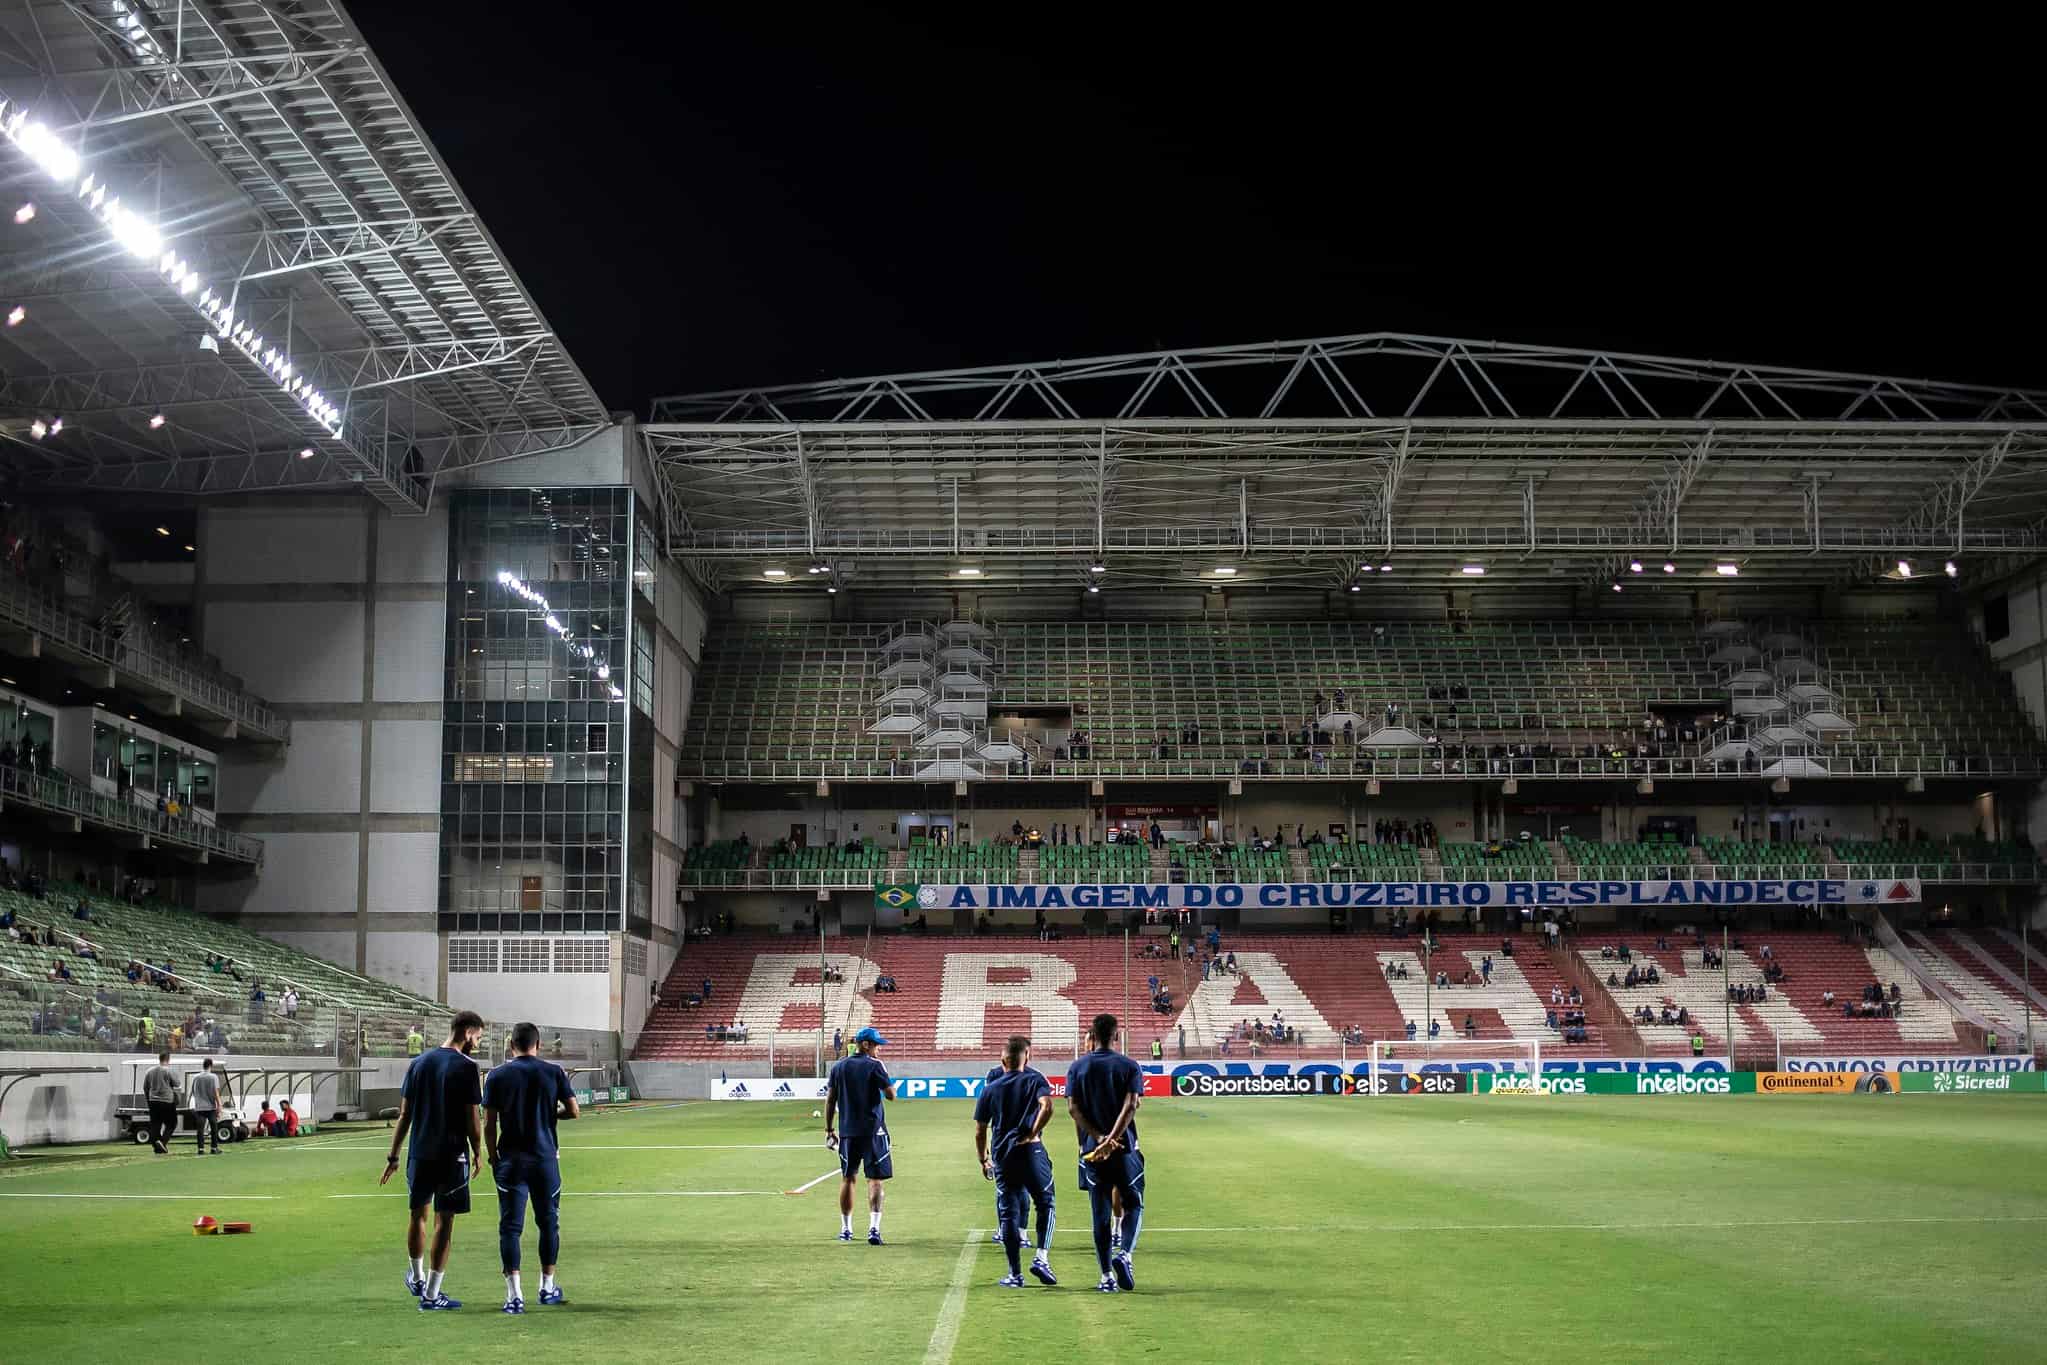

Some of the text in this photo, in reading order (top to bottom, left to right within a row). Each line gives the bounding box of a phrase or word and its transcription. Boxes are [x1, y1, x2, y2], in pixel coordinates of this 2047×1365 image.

[950, 880, 1846, 908] A IMAGEM DO CRUZEIRO RESPLANDECE
[1199, 1075, 1311, 1097] Sportsbet.io
[1424, 1075, 1456, 1092] elo
[1637, 1074, 1731, 1094] intelbras
[1762, 1074, 1834, 1091] Continental
[1955, 1075, 2011, 1090] Sicredi
